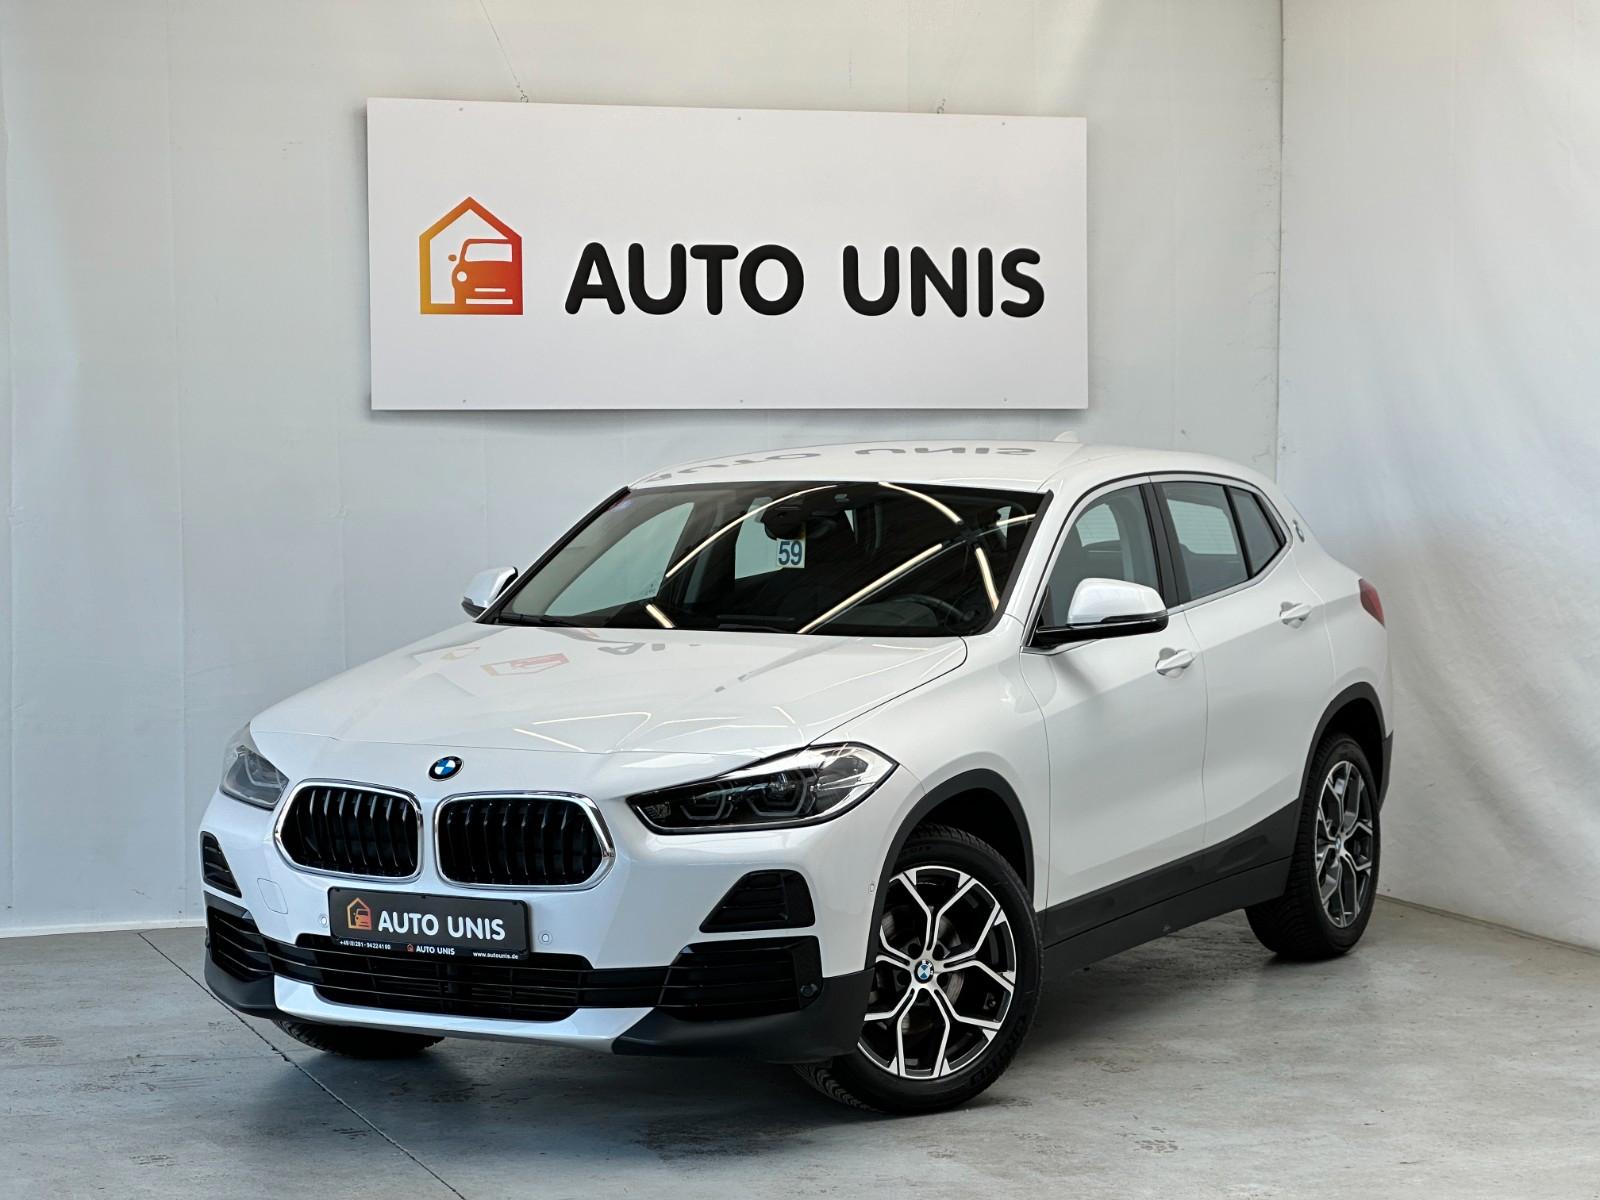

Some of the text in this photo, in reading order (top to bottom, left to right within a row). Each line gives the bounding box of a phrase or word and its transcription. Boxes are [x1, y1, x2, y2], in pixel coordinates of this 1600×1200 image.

[564, 242, 1045, 318] AUTO UNIS
[778, 541, 802, 566] 59
[377, 910, 506, 941] AUTO UNIS
[415, 945, 456, 956] AUTO UNIS
